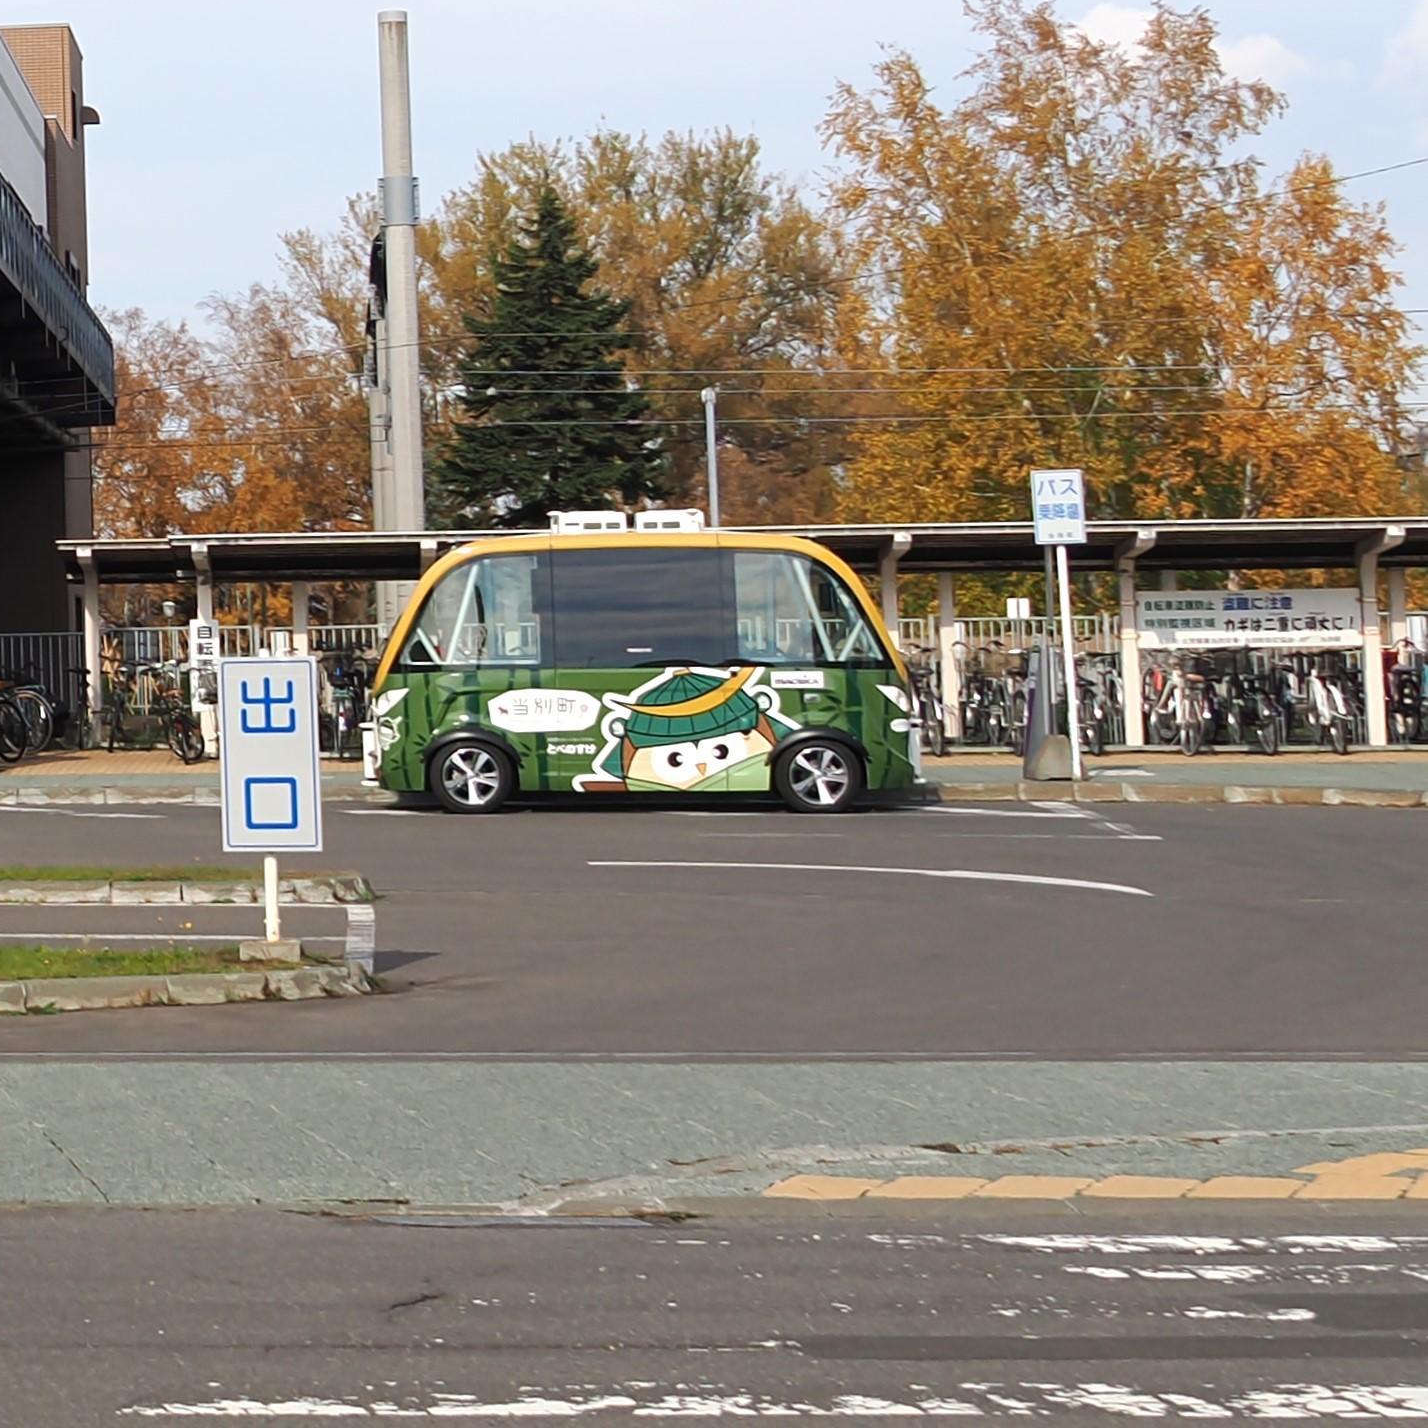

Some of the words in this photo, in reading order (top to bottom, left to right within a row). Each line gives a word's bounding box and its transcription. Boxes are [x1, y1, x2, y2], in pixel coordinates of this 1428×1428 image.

[1037, 478, 1079, 496] バス
[512, 698, 576, 715] 当別町
[240, 677, 298, 829] 出口
